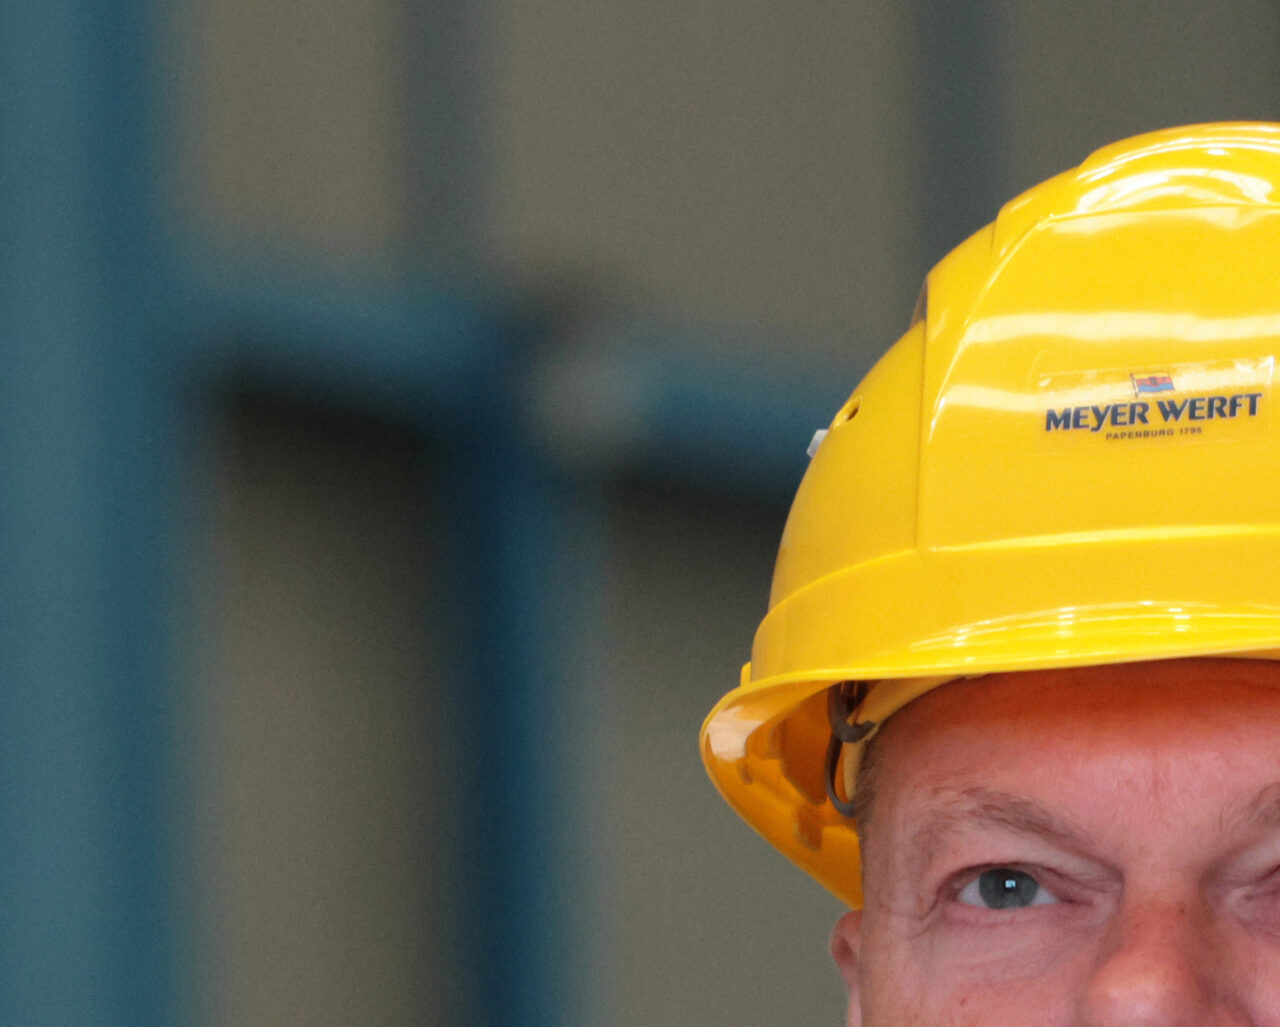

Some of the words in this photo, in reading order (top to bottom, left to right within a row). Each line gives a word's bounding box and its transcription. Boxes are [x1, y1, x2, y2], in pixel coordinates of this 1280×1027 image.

[1045, 402, 1149, 432] MEYER
[1157, 393, 1262, 423] WERFT
[1106, 429, 1174, 440] PAPENBURG
